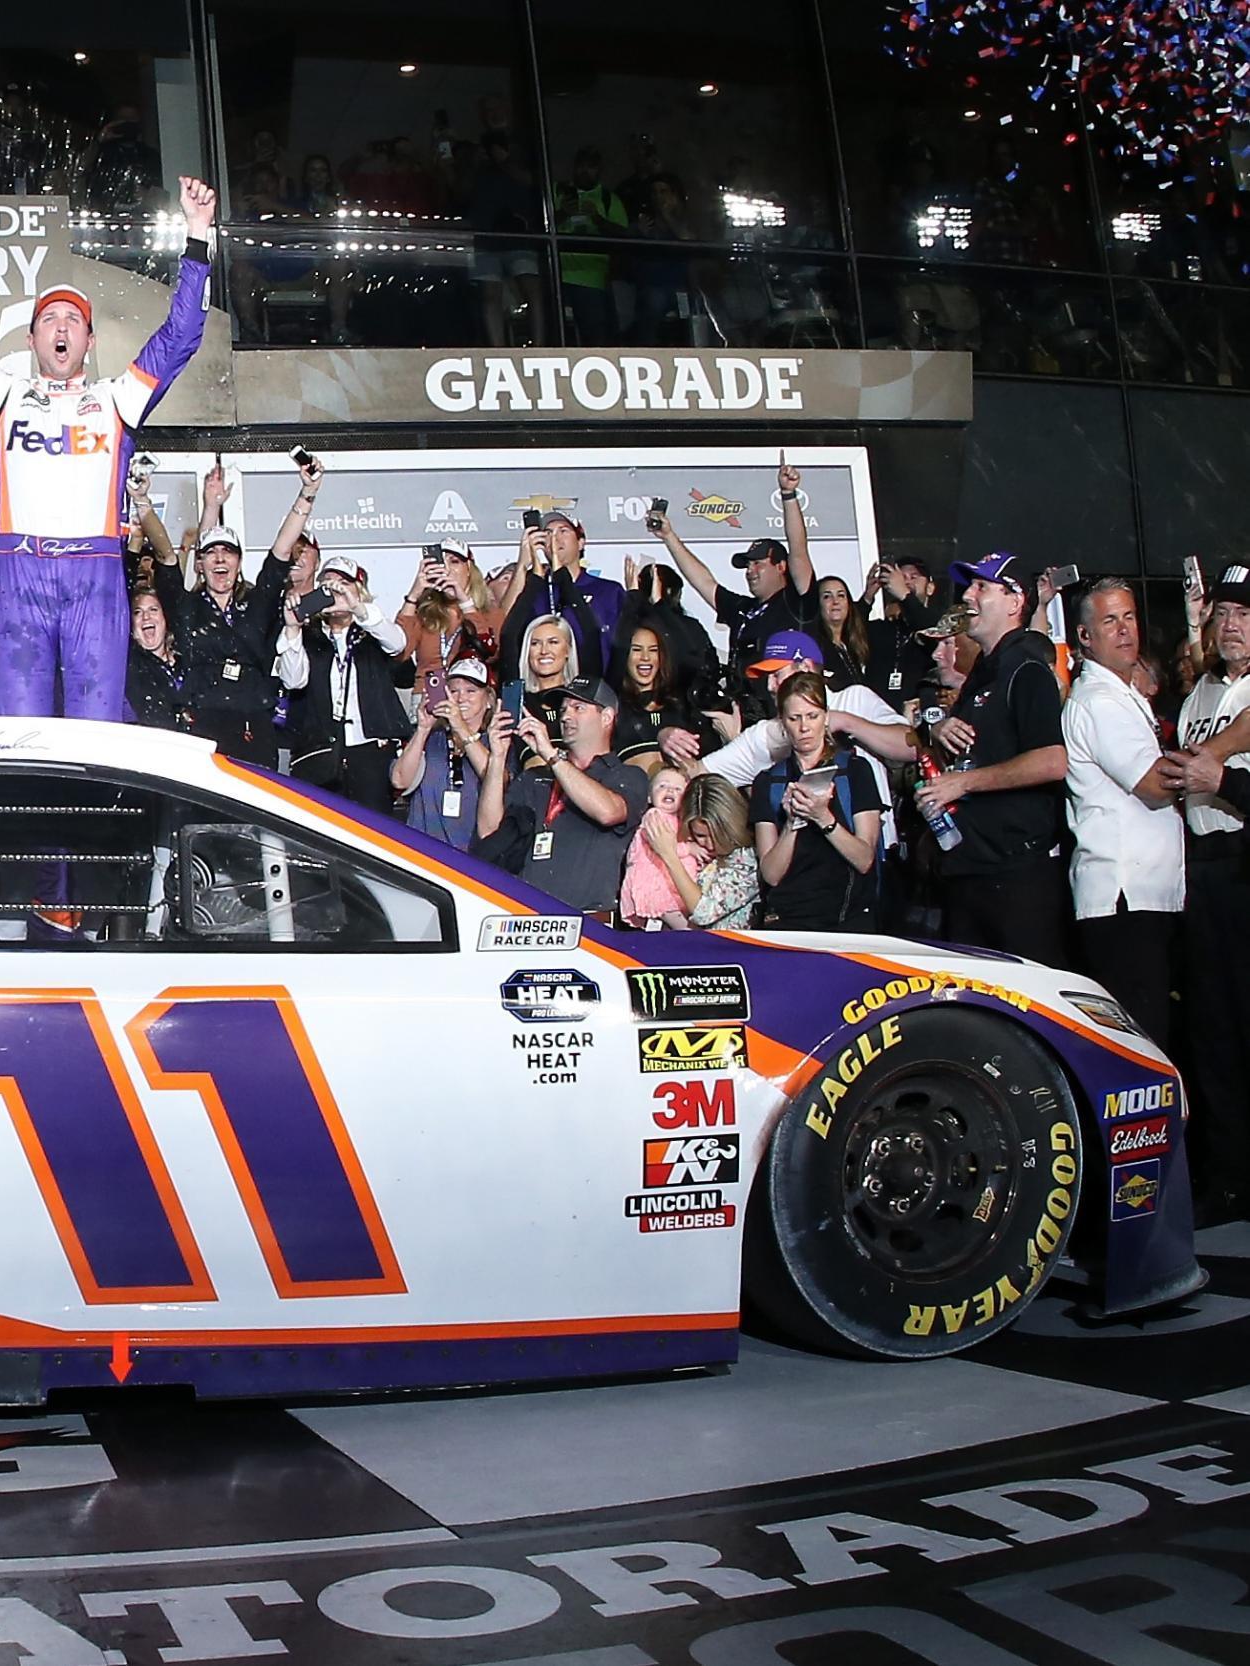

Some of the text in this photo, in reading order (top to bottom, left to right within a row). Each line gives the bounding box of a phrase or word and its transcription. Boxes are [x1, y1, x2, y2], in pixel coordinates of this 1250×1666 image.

[47, 380, 83, 392] FedEx
[424, 356, 804, 412] GATORADE
[6, 419, 111, 456] FedEx
[690, 503, 742, 515] SUNOCO
[304, 513, 403, 532] ventHealth
[425, 521, 479, 533] AXALTA
[765, 516, 820, 528] TOTA
[513, 919, 569, 934] NASCAR
[494, 935, 566, 947] RACE CAR
[532, 973, 573, 983] NASCAR
[669, 975, 740, 988] MONSTER
[516, 985, 584, 1006] HEAT
[842, 972, 1033, 1025] GOODYEAR
[512, 1032, 595, 1049] NASCAR
[527, 1052, 582, 1069] HEAT
[642, 1057, 708, 1072] MECHANIX
[532, 1072, 577, 1085] .com
[806, 1014, 904, 1140] EAGLE
[652, 1079, 736, 1130] 3M
[1103, 1082, 1175, 1120] MOOG
[1110, 1124, 1168, 1154] Edelbrock
[628, 1191, 719, 1215] LINCOLN
[647, 1212, 726, 1231] WELDERS
[902, 1120, 1076, 1338] GOODYEAR
